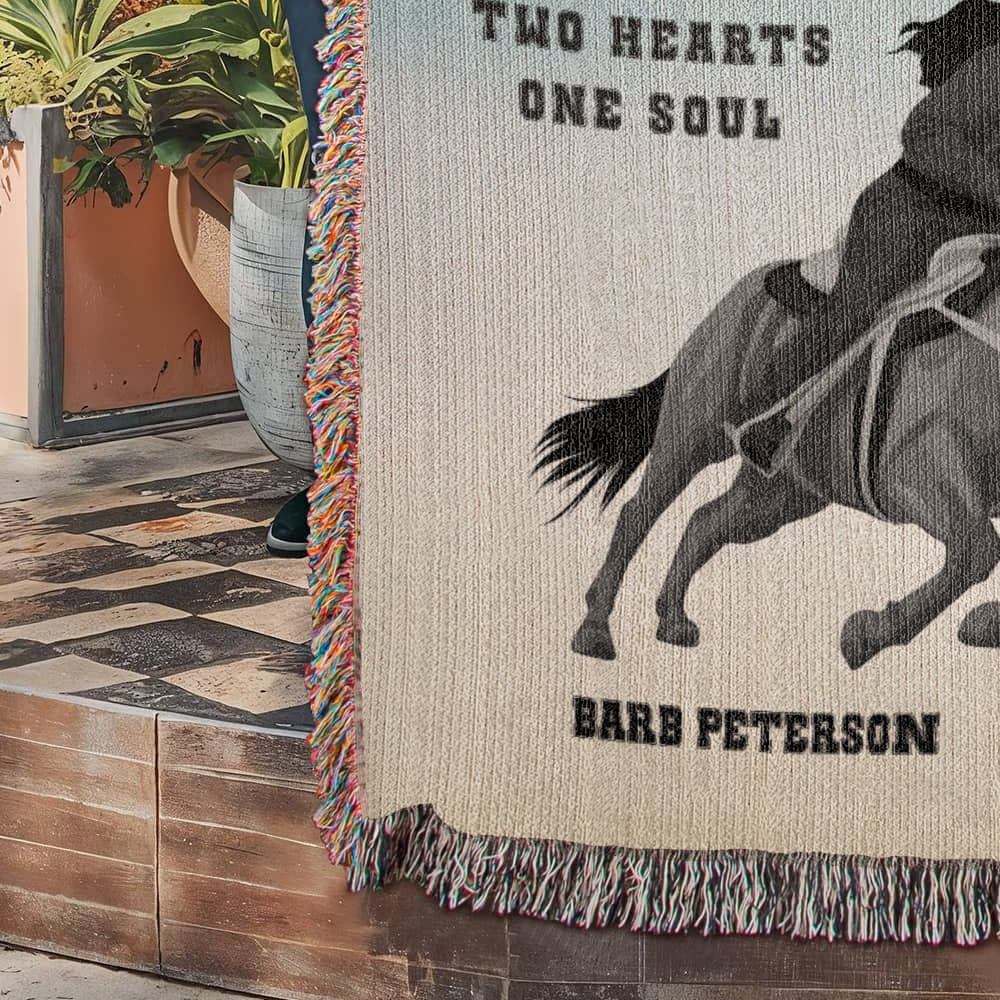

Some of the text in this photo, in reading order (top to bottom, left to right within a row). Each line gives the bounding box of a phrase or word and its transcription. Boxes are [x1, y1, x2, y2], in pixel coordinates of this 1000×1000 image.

[611, 17, 829, 66] HEARTS
[519, 79, 780, 139] ONE SOUL
[573, 696, 940, 755] BARB PETERSON
